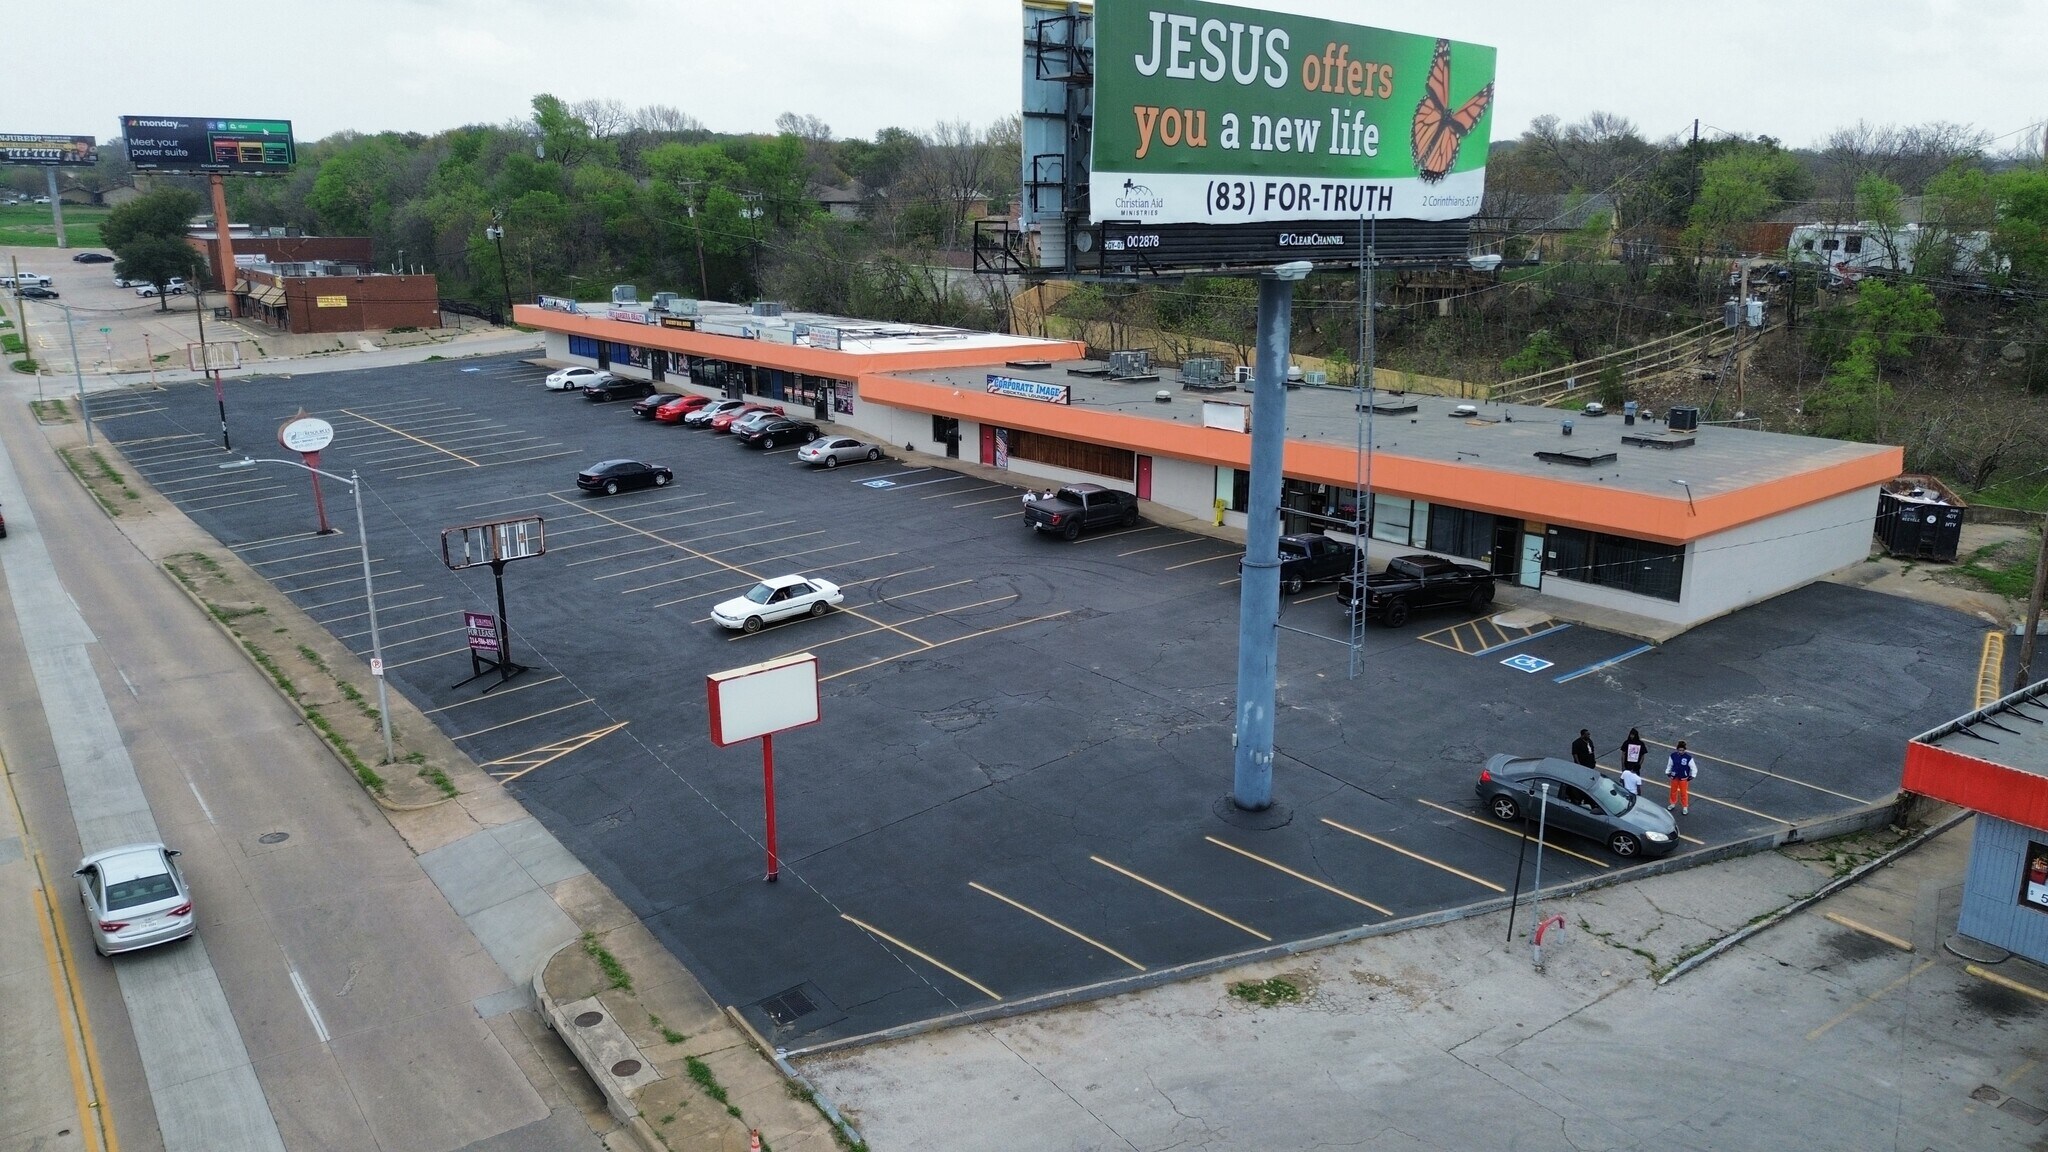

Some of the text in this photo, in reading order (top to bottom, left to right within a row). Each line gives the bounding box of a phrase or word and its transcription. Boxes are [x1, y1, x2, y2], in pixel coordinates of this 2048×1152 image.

[1134, 11, 1394, 100] JESUS offers
[1134, 105, 1379, 159] you a new life
[130, 138, 179, 148] Meet your
[6, 148, 61, 157] 777-7777
[131, 148, 188, 157] power suite
[1115, 197, 1163, 208] Christian Aid
[1206, 180, 1393, 215] (83) FOR-TRUTH
[1422, 196, 1479, 207] 2 Corinthians 5:17
[994, 378, 1060, 397] CORPORATE IMAGE
[1002, 389, 1027, 397] COCKTAIL
[468, 628, 495, 638] FOR LEASE
[1680, 757, 1688, 766] S
[2040, 893, 2048, 904] 5
